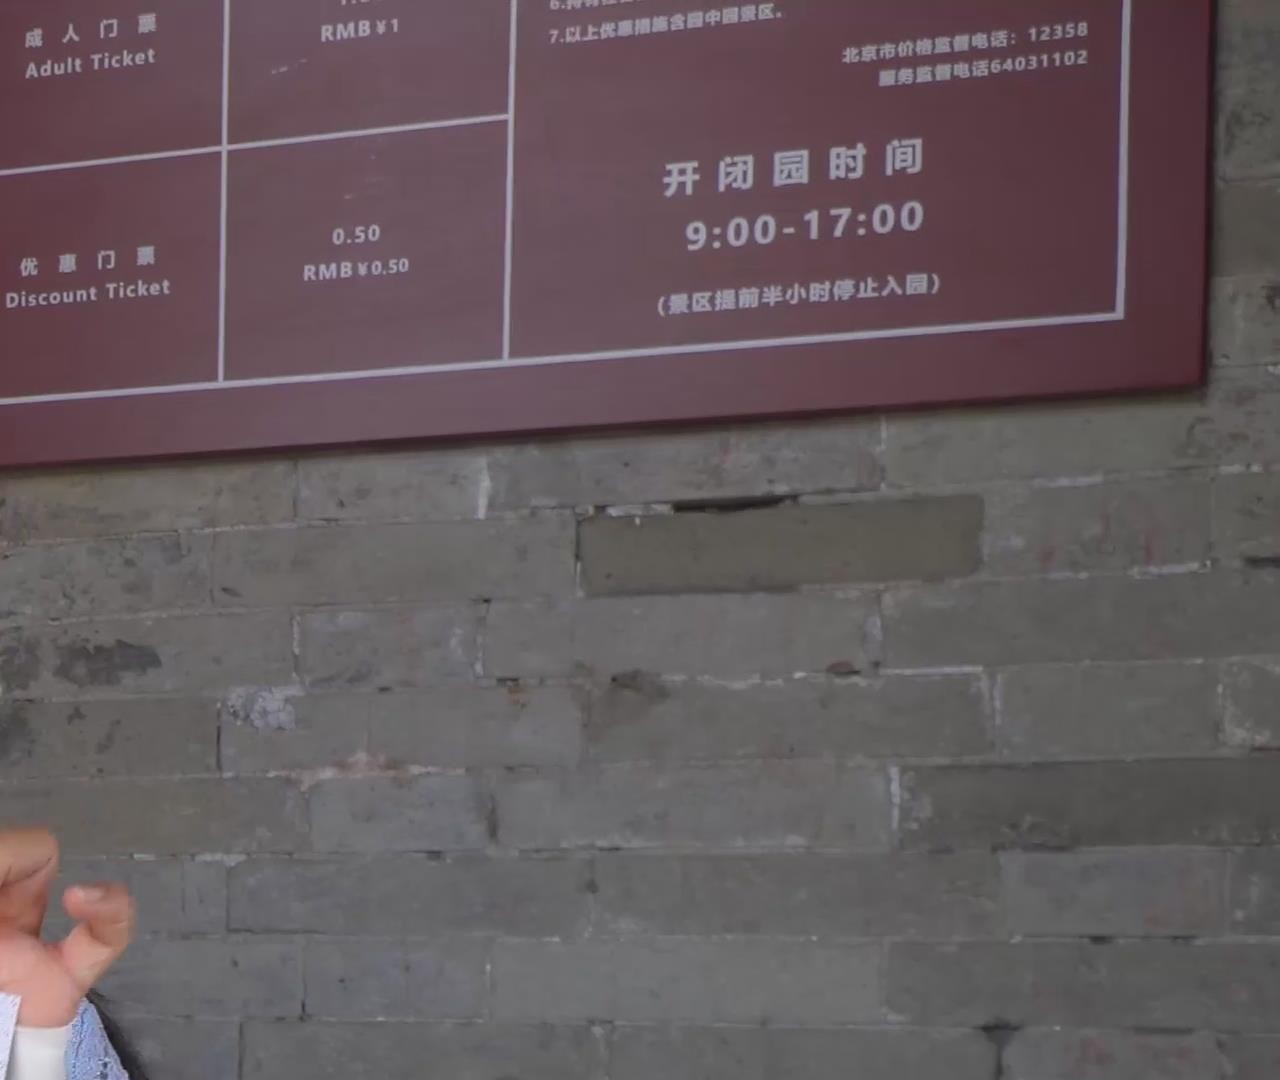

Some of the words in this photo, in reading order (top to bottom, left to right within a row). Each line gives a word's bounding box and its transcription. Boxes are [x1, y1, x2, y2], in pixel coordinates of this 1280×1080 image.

[24, 14, 158, 48] 成人门票
[25, 56, 83, 79] Adult
[90, 48, 157, 70] Ticket
[662, 138, 925, 197] 开闭园时间
[331, 225, 381, 245] 0.50
[685, 201, 925, 250] 9:00-17:00
[19, 246, 157, 277] 优惠门票
[5, 286, 99, 309] Discount
[105, 279, 172, 300] Ticket
